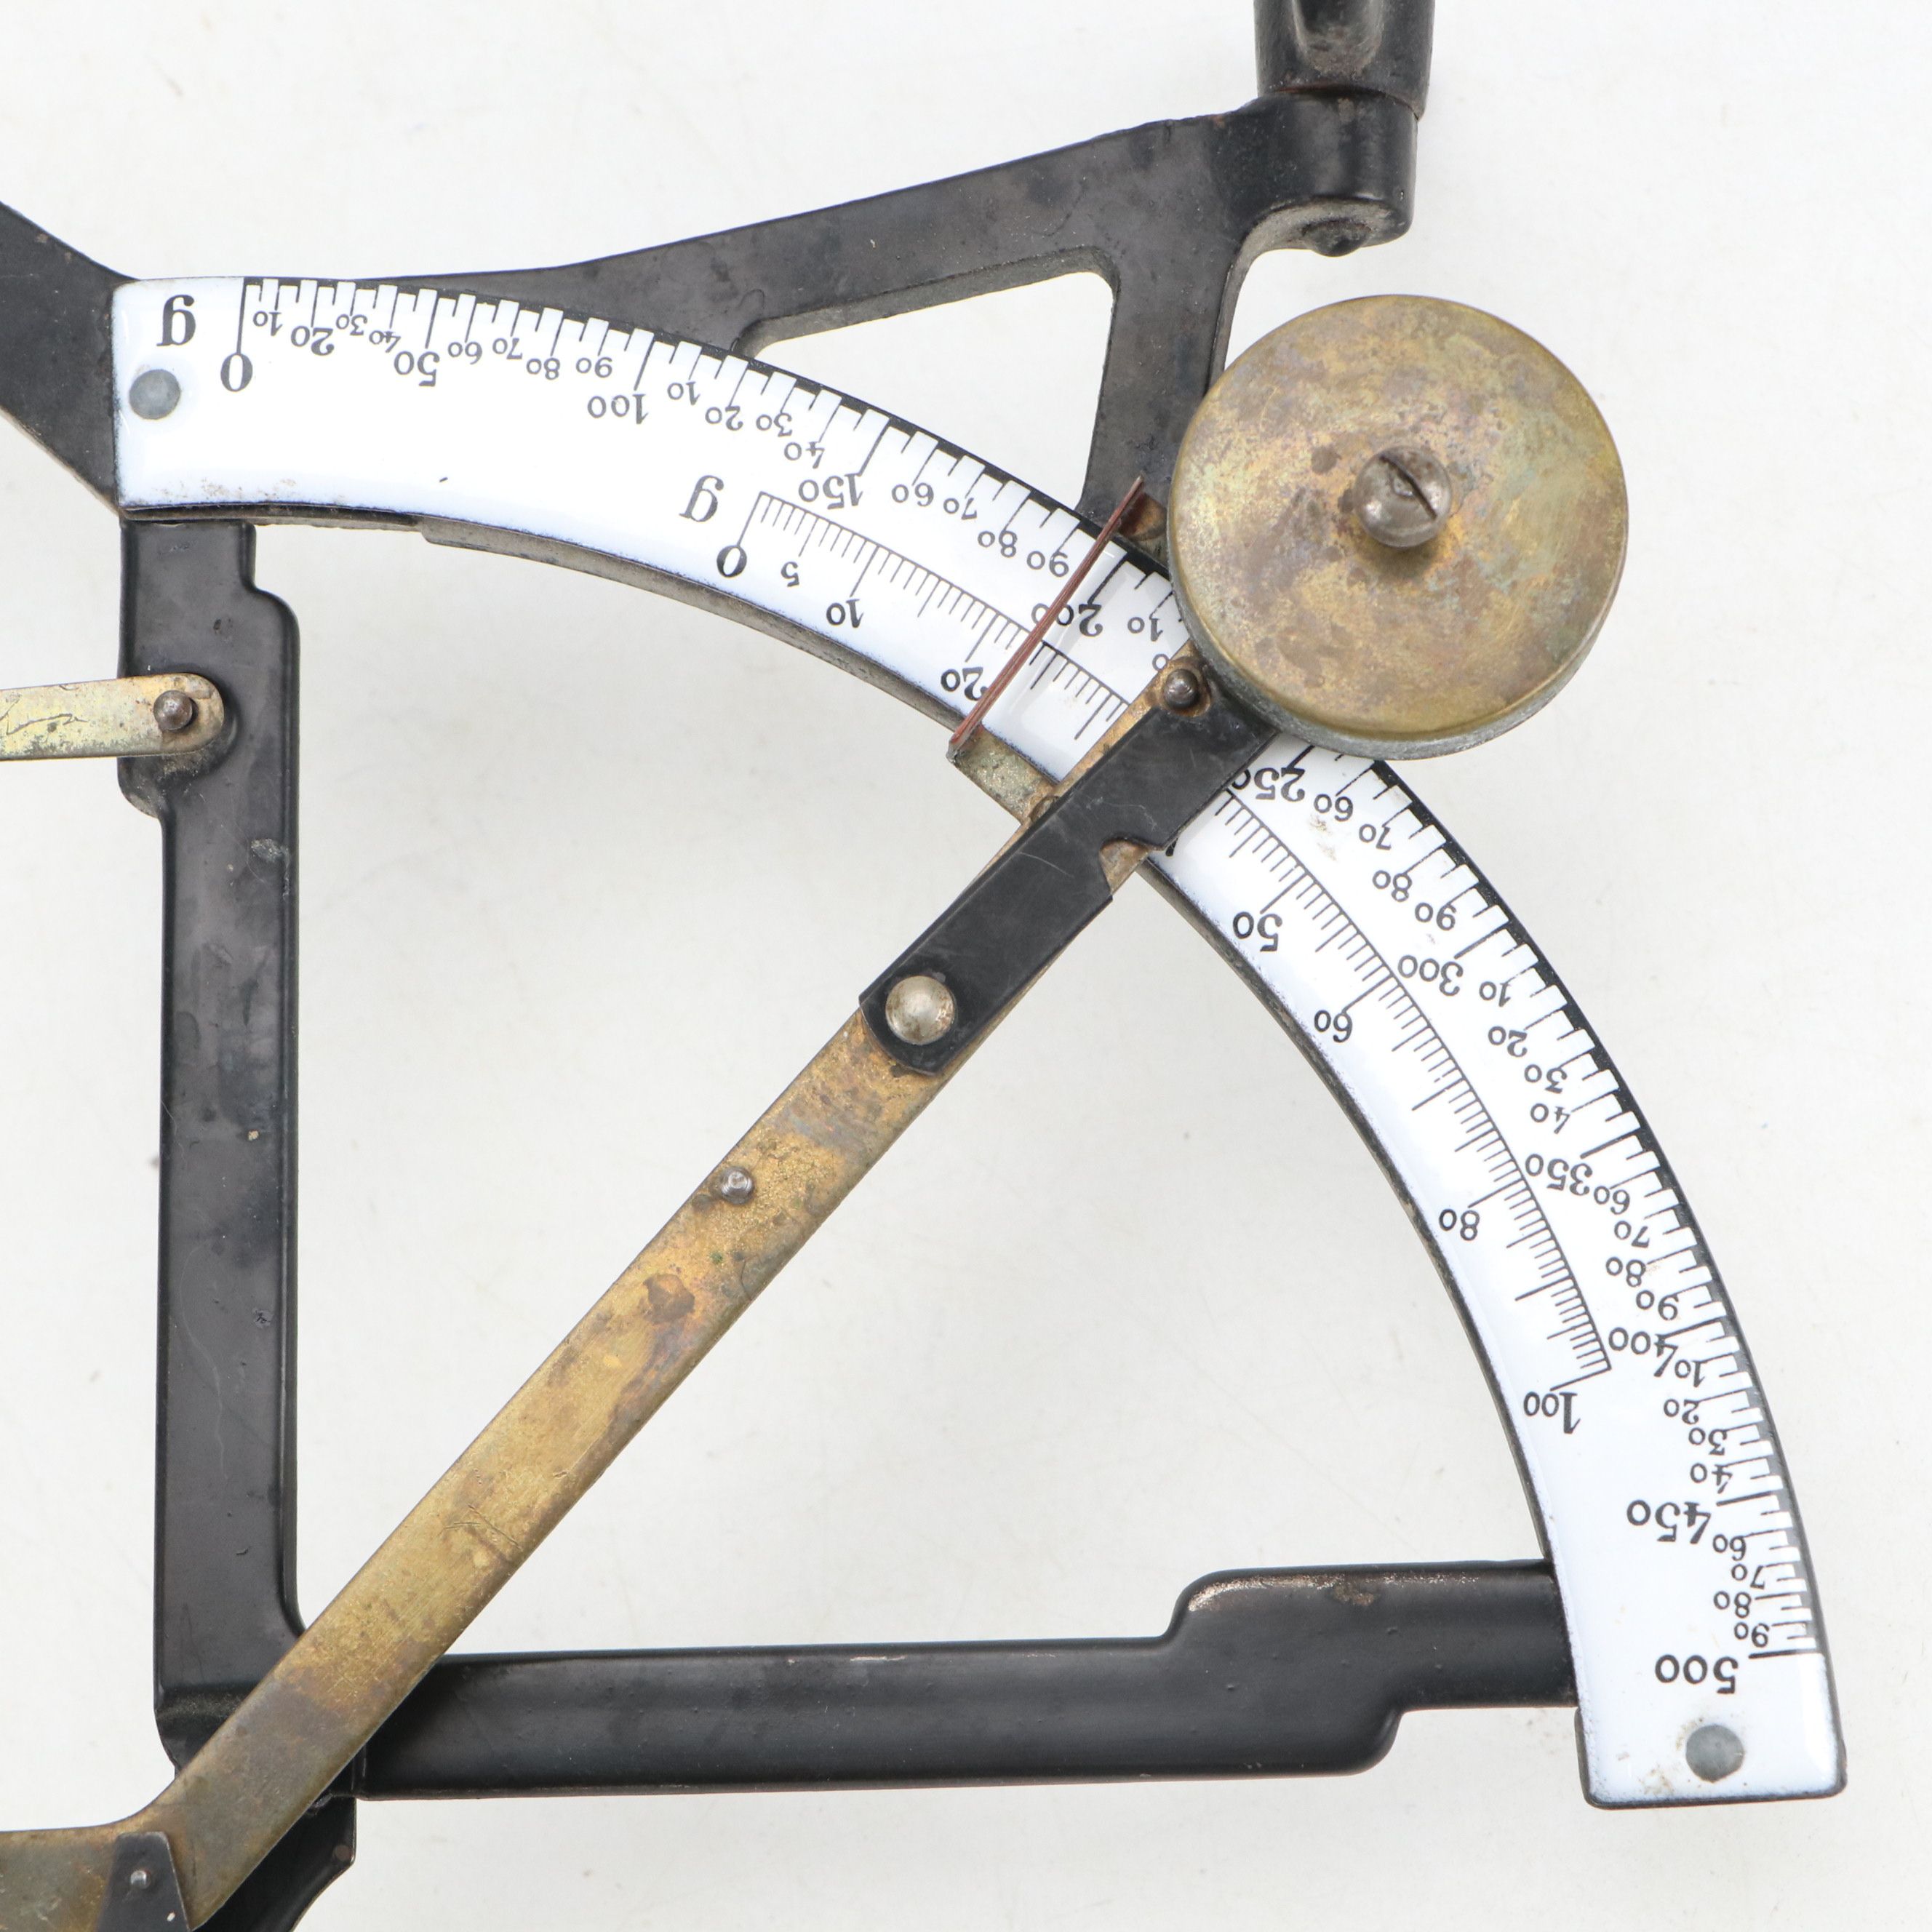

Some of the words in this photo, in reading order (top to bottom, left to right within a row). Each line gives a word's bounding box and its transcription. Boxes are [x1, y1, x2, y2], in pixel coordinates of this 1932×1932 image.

[156, 294, 196, 347] g
[253, 310, 284, 337] 10
[335, 314, 368, 337] 30
[291, 324, 335, 355] 20
[369, 329, 402, 352] 40
[447, 340, 483, 364] 60
[492, 338, 523, 360] 70
[220, 352, 252, 391] 0
[394, 350, 440, 387] 50
[526, 356, 560, 380] 80
[575, 356, 612, 378] 90
[667, 380, 701, 405] 10
[587, 394, 649, 424] 100
[705, 406, 743, 431] 20
[756, 412, 793, 437] 30
[784, 441, 826, 469] 40
[679, 475, 724, 523] g
[799, 474, 864, 509] 150
[891, 483, 935, 506] 60
[943, 495, 978, 520] 70
[978, 530, 1018, 556] 80
[716, 544, 747, 578] 0
[781, 561, 800, 588] 5
[1026, 551, 1070, 578] 90
[826, 599, 865, 629] 10
[1031, 602, 1103, 636] 200
[1127, 616, 1163, 642] 10
[941, 666, 989, 700] 20
[1314, 793, 1353, 821] 60
[1359, 823, 1392, 850] 70
[1373, 869, 1413, 902] 80
[1233, 910, 1282, 952] 50
[1414, 902, 1456, 930] 90
[1397, 954, 1464, 997] 300
[1479, 981, 1513, 1007] 10
[1314, 1009, 1352, 1042] 60
[1488, 1026, 1528, 1057] 20
[1524, 1063, 1568, 1093] 30
[1530, 1103, 1570, 1134] 40
[1525, 1153, 1593, 1196] 350
[1593, 1185, 1630, 1215] 60
[1439, 1208, 1481, 1242] 80
[1614, 1219, 1650, 1248] 70
[1605, 1256, 1646, 1288] 80
[1636, 1288, 1680, 1320] 90
[1608, 1326, 1677, 1377] 400
[1674, 1358, 1704, 1388] 10
[1524, 1390, 1581, 1434] 100
[1664, 1397, 1700, 1424] 20
[1688, 1426, 1728, 1455] 30
[1690, 1463, 1733, 1493] 40
[1627, 1498, 1712, 1544] 450
[1713, 1534, 1747, 1562] 60
[1731, 1562, 1765, 1589] 70
[1713, 1591, 1752, 1618] 80
[1734, 1621, 1770, 1648] 90
[1655, 1654, 1740, 1694] 500
